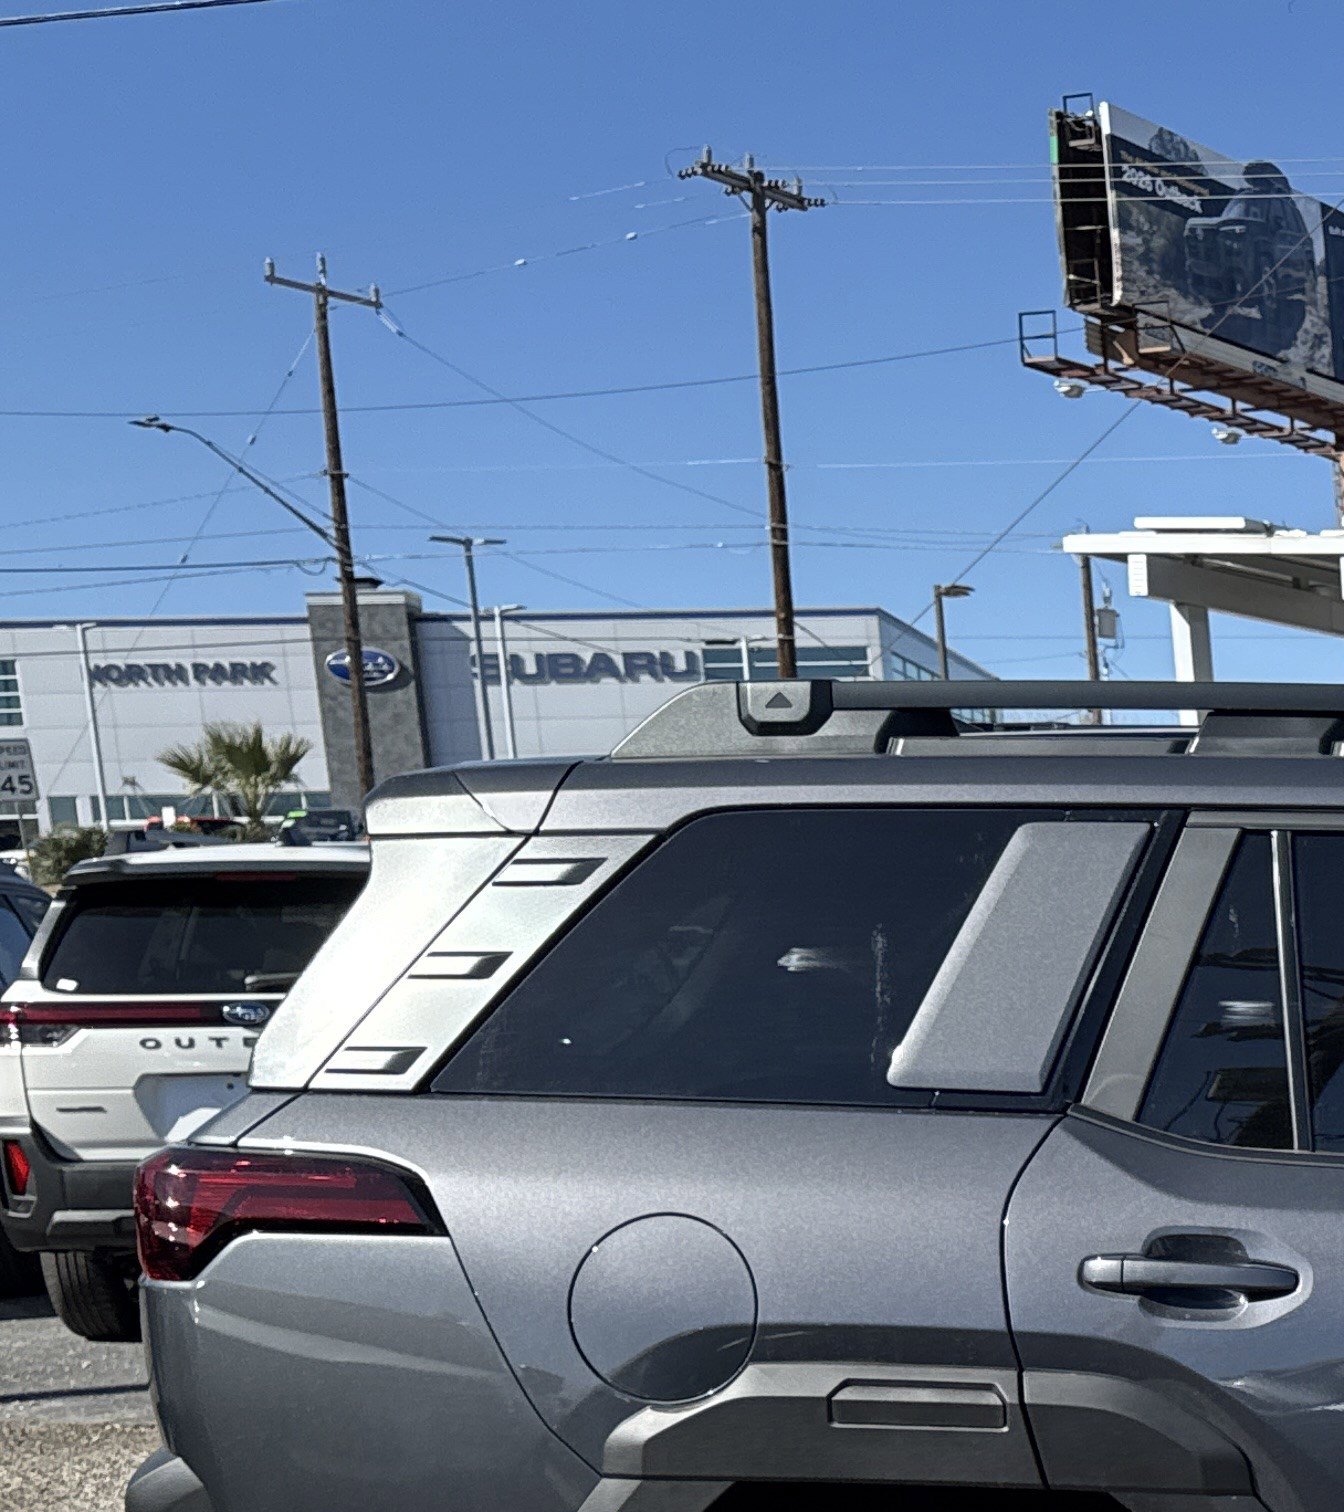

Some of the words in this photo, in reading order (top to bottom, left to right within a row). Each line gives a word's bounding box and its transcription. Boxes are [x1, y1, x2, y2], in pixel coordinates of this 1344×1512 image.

[87, 663, 190, 689] NORTH
[191, 662, 279, 687] PARK
[471, 651, 701, 686] SUBARU
[0, 774, 34, 795] 45
